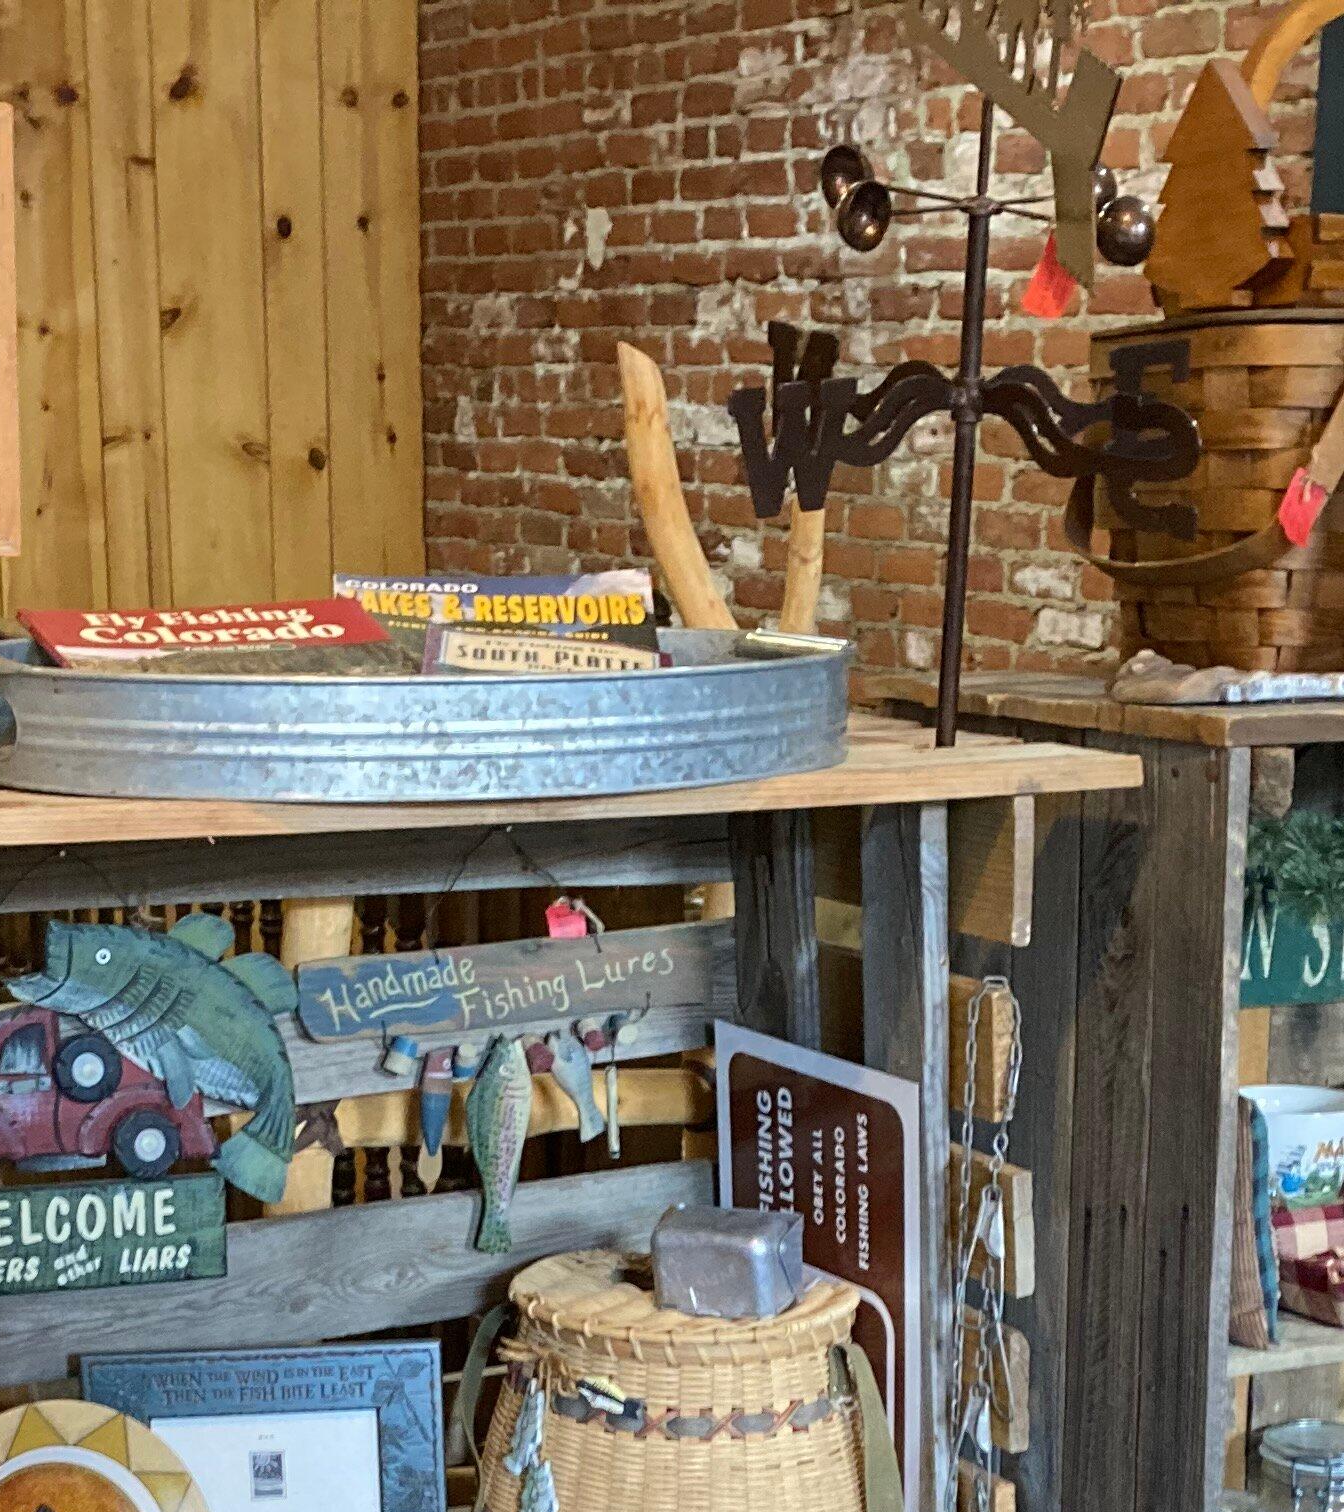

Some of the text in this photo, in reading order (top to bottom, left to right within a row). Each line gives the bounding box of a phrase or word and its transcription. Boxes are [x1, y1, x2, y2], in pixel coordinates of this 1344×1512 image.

[344, 578, 480, 594] COLORADO
[81, 604, 317, 631] Fly Fishing
[349, 590, 434, 620] AKES
[472, 593, 648, 626] RESERVOIRS
[78, 621, 347, 646] Colorado
[316, 947, 675, 1032] Handmade Fishing Lures
[811, 1127, 825, 1226] OBEY ALL
[832, 1125, 848, 1245] COLORADO
[856, 1112, 870, 1272] FISHING LAWS
[53, 1244, 89, 1271] and
[119, 1244, 192, 1275] LIARS
[233, 1368, 279, 1386] WIND
[238, 1385, 275, 1403] FISH
